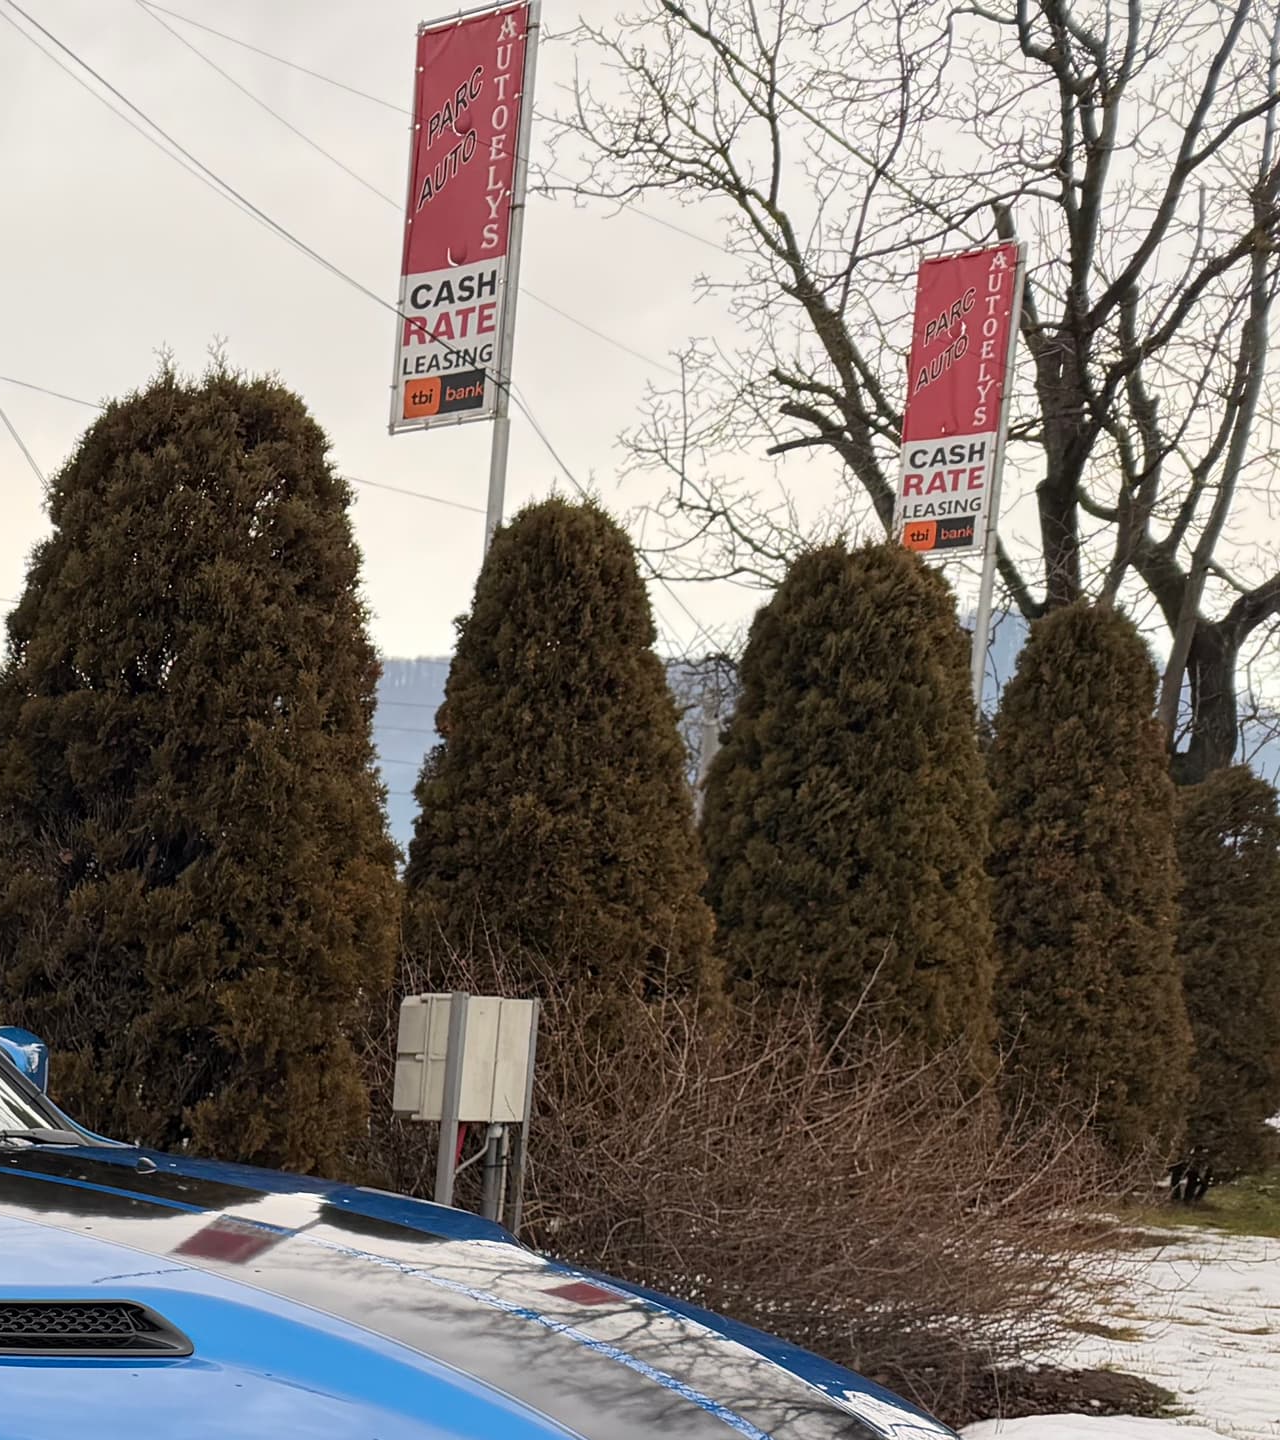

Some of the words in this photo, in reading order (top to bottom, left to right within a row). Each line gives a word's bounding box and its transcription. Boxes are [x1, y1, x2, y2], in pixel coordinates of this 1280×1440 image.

[427, 65, 484, 150] PARC
[481, 14, 518, 249] AUTOELYS
[416, 130, 477, 213] AUTO
[410, 270, 497, 310] CASH
[402, 301, 497, 347] RATE
[923, 286, 976, 348] PARC
[973, 250, 1009, 426] AUTOELYS
[402, 344, 493, 376] LEASING
[913, 335, 969, 396] AUTO
[411, 388, 433, 406] tbi
[445, 381, 483, 402] bank
[909, 441, 986, 469] CASH
[902, 465, 986, 497] RATE
[902, 497, 982, 519] LEASING
[910, 530, 929, 542] tbi
[941, 525, 973, 540] bank
